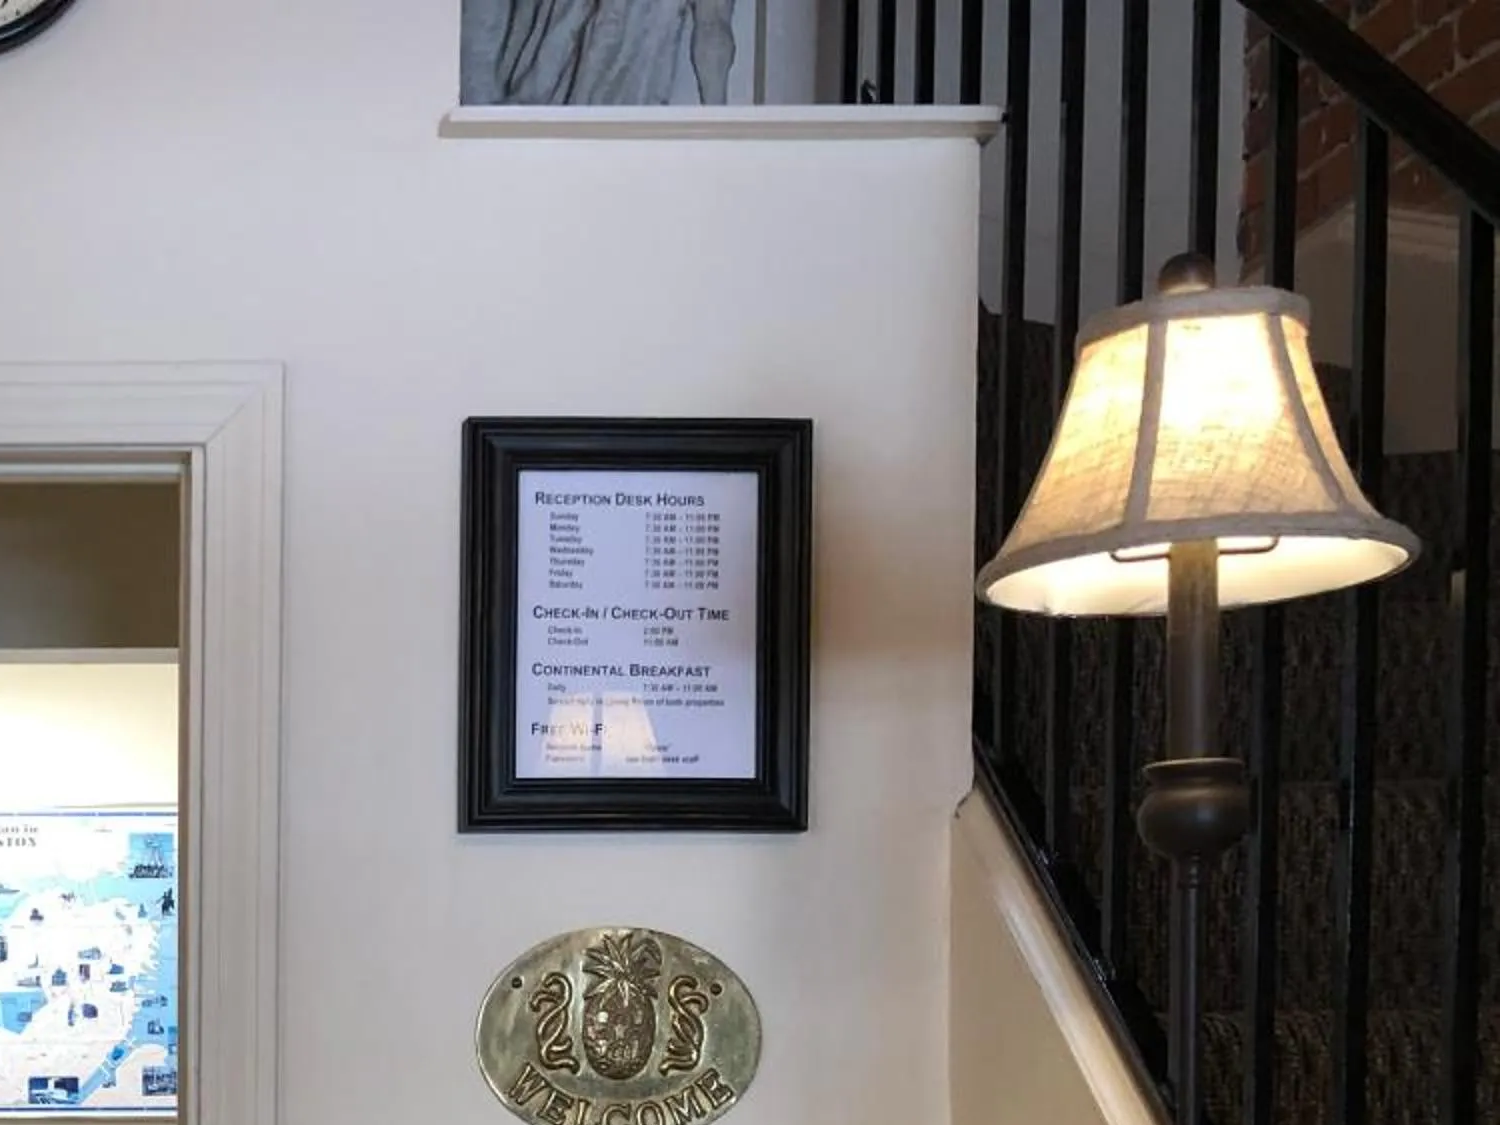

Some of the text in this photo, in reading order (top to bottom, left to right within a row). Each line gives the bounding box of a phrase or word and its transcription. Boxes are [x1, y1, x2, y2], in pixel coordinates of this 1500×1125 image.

[534, 491, 705, 507] RECEPTION DESK HOURS
[533, 604, 599, 619] CHECK-IN
[611, 605, 694, 621] CHECK-OUT
[697, 606, 731, 621] TIME
[531, 661, 712, 678] CONTINENTAL BREAKFAST
